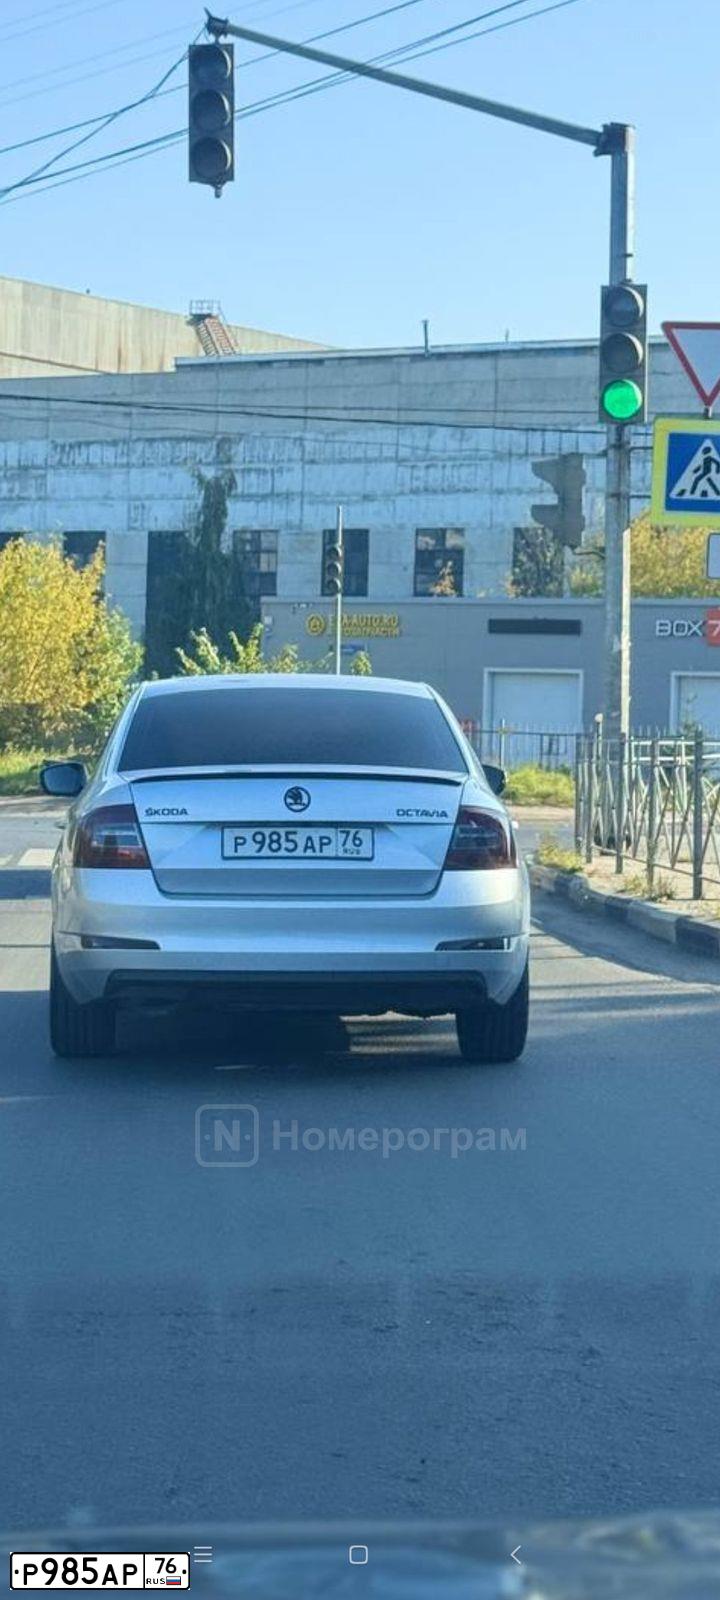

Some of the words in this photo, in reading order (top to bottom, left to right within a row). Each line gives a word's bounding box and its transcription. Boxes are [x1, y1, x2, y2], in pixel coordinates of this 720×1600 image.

[656, 619, 703, 637] BOX
[396, 808, 449, 818] OCTAVIA
[339, 830, 363, 848] 76
